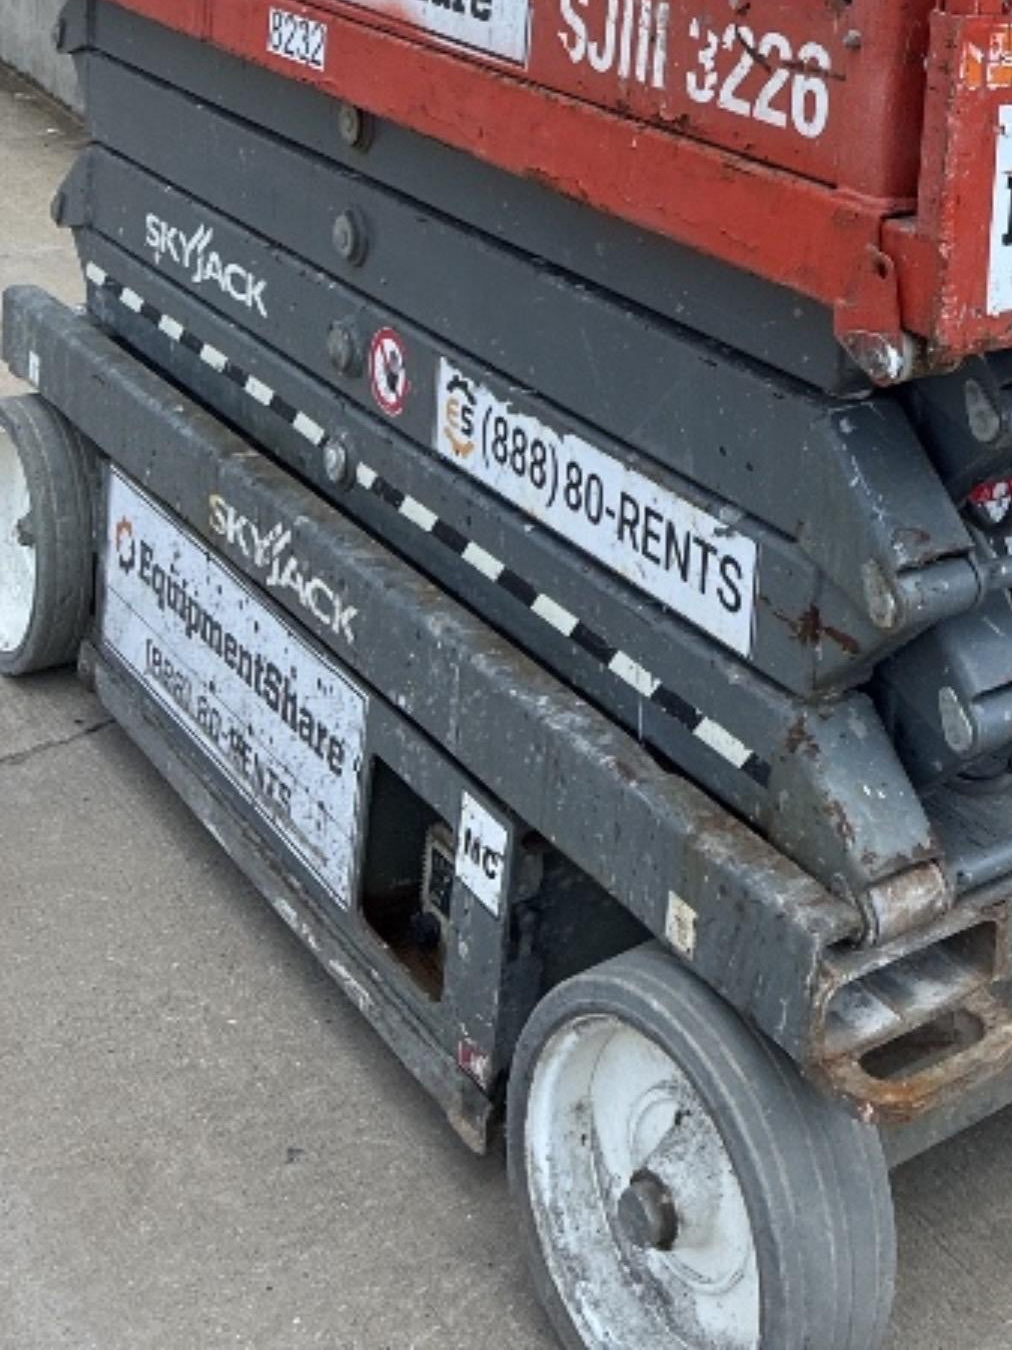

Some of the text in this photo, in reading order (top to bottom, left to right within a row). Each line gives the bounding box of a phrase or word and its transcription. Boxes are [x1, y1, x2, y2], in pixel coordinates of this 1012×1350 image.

[272, 12, 325, 67] 8232
[686, 17, 831, 138] 3226
[145, 213, 267, 318] SKYJACK
[208, 493, 359, 644] SKYJACK
[140, 539, 345, 776] EquipmentShare
